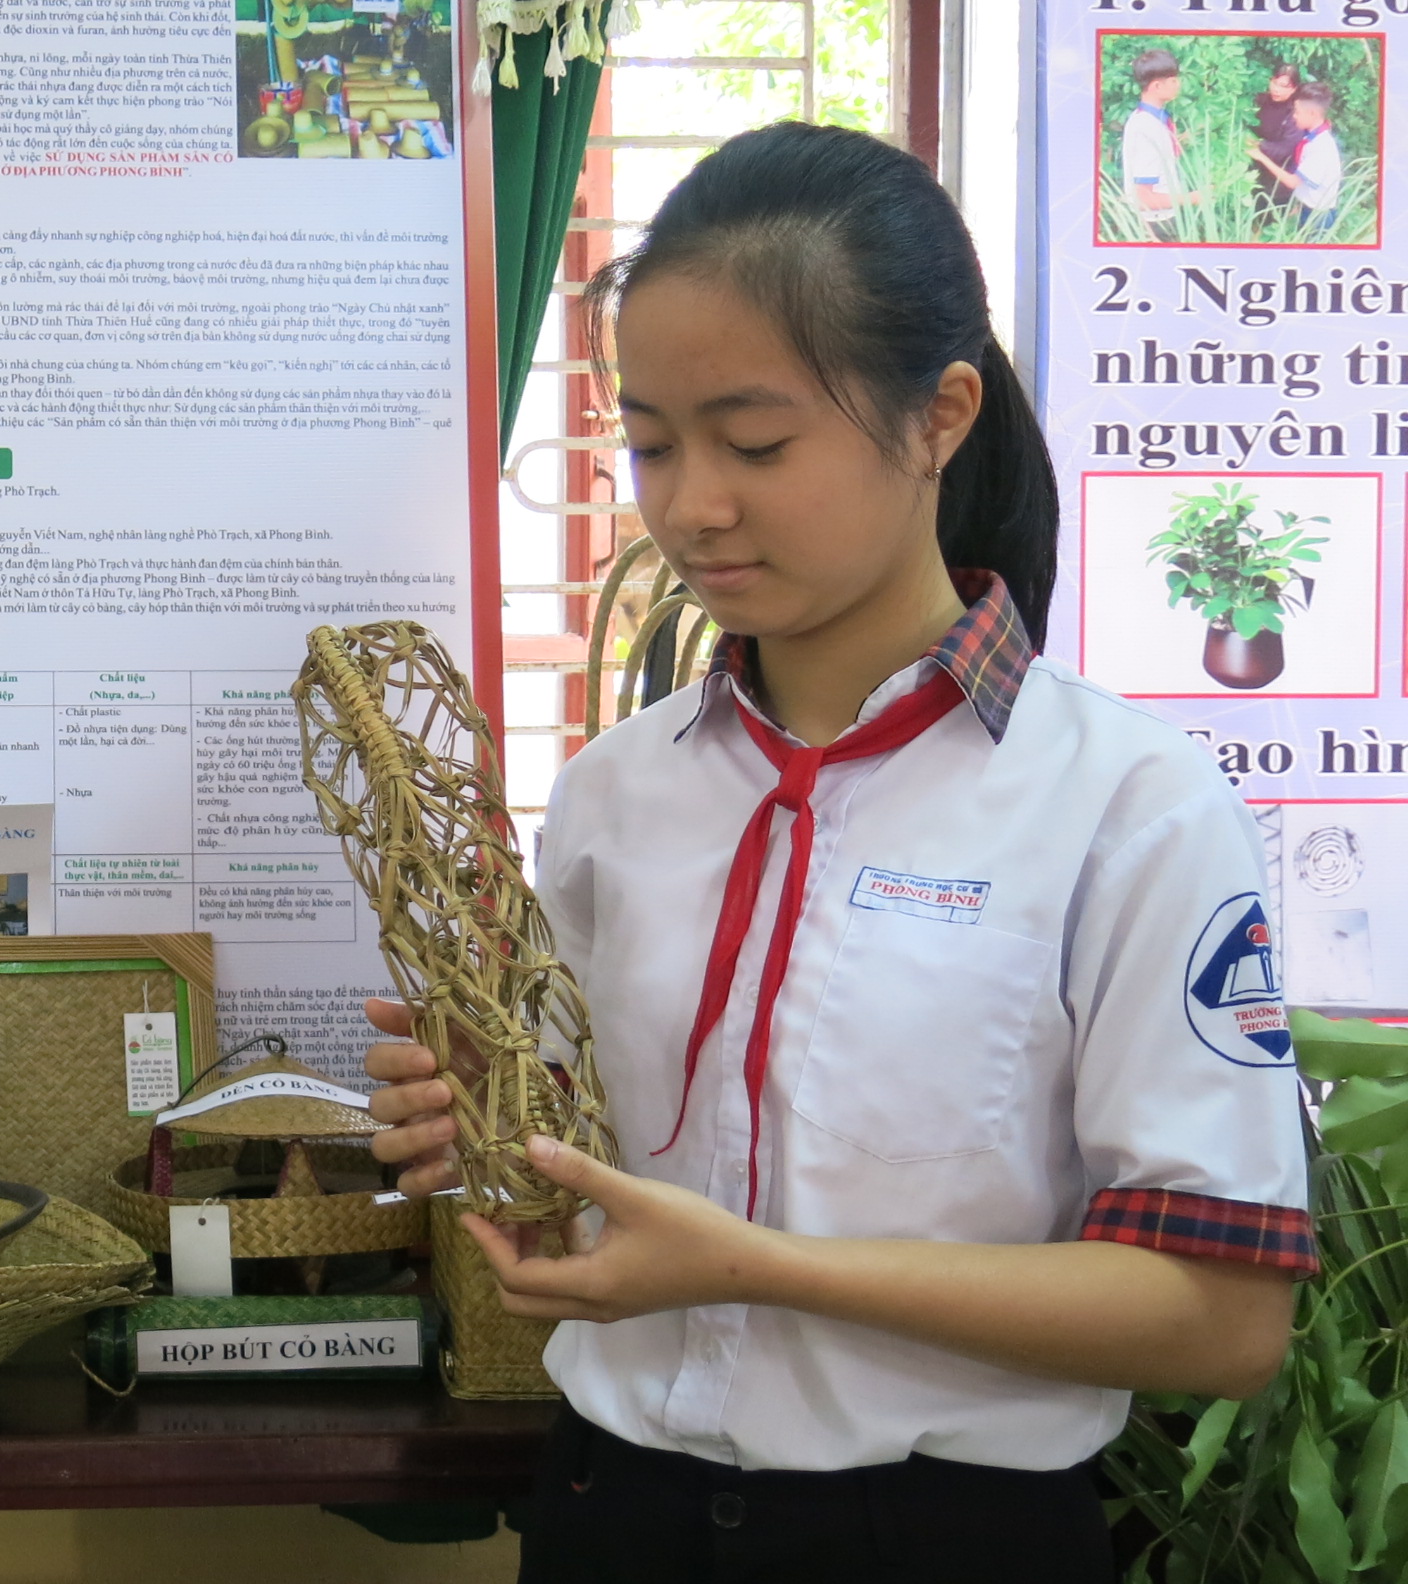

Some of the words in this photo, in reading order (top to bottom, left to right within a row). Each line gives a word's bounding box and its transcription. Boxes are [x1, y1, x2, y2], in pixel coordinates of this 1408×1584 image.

[1094, 267, 1152, 312] 2.
[1093, 339, 1321, 397] những
[1345, 341, 1408, 385] ti
[1092, 409, 1344, 468] nguyên
[1186, 731, 1293, 787] ạo
[870, 881, 931, 901] PHONG
[936, 891, 980, 907] BÌNH
[1240, 1019, 1280, 1033] PHONG
[221, 1080, 254, 1099] ĐÈN
[259, 1075, 285, 1089] CỎ
[291, 1079, 338, 1097] BÀNG
[161, 1342, 214, 1366] HỘP
[222, 1337, 272, 1360] BÚT
[279, 1334, 316, 1358] CỎ
[324, 1332, 394, 1356] BÀNG
